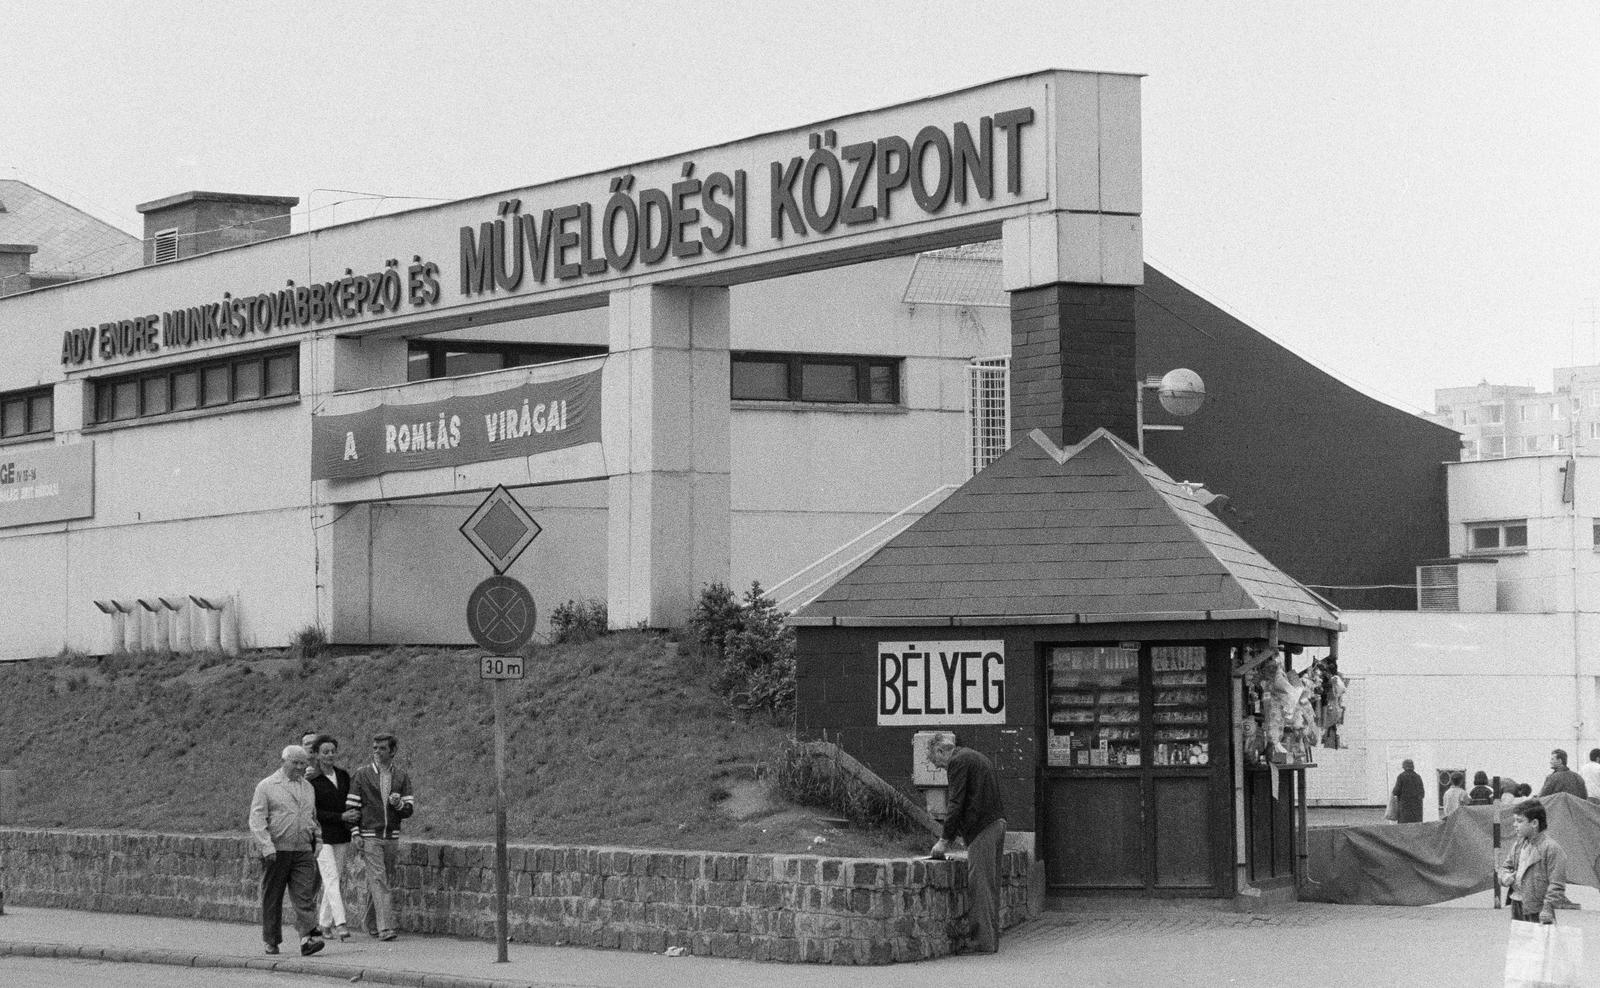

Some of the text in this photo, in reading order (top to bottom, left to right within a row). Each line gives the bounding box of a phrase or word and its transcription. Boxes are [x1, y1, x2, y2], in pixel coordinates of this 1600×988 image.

[61, 327, 97, 364] ADY
[99, 314, 159, 360] ENDRE
[408, 254, 440, 307] ÉS
[460, 161, 747, 297] MŰVELŐDÉSI
[770, 106, 1034, 241] KÖZPONT
[344, 399, 567, 461] A ROMLÁS VIRÁGAI
[486, 659, 520, 675] 30 m
[879, 644, 1005, 716] BÉLYEG
